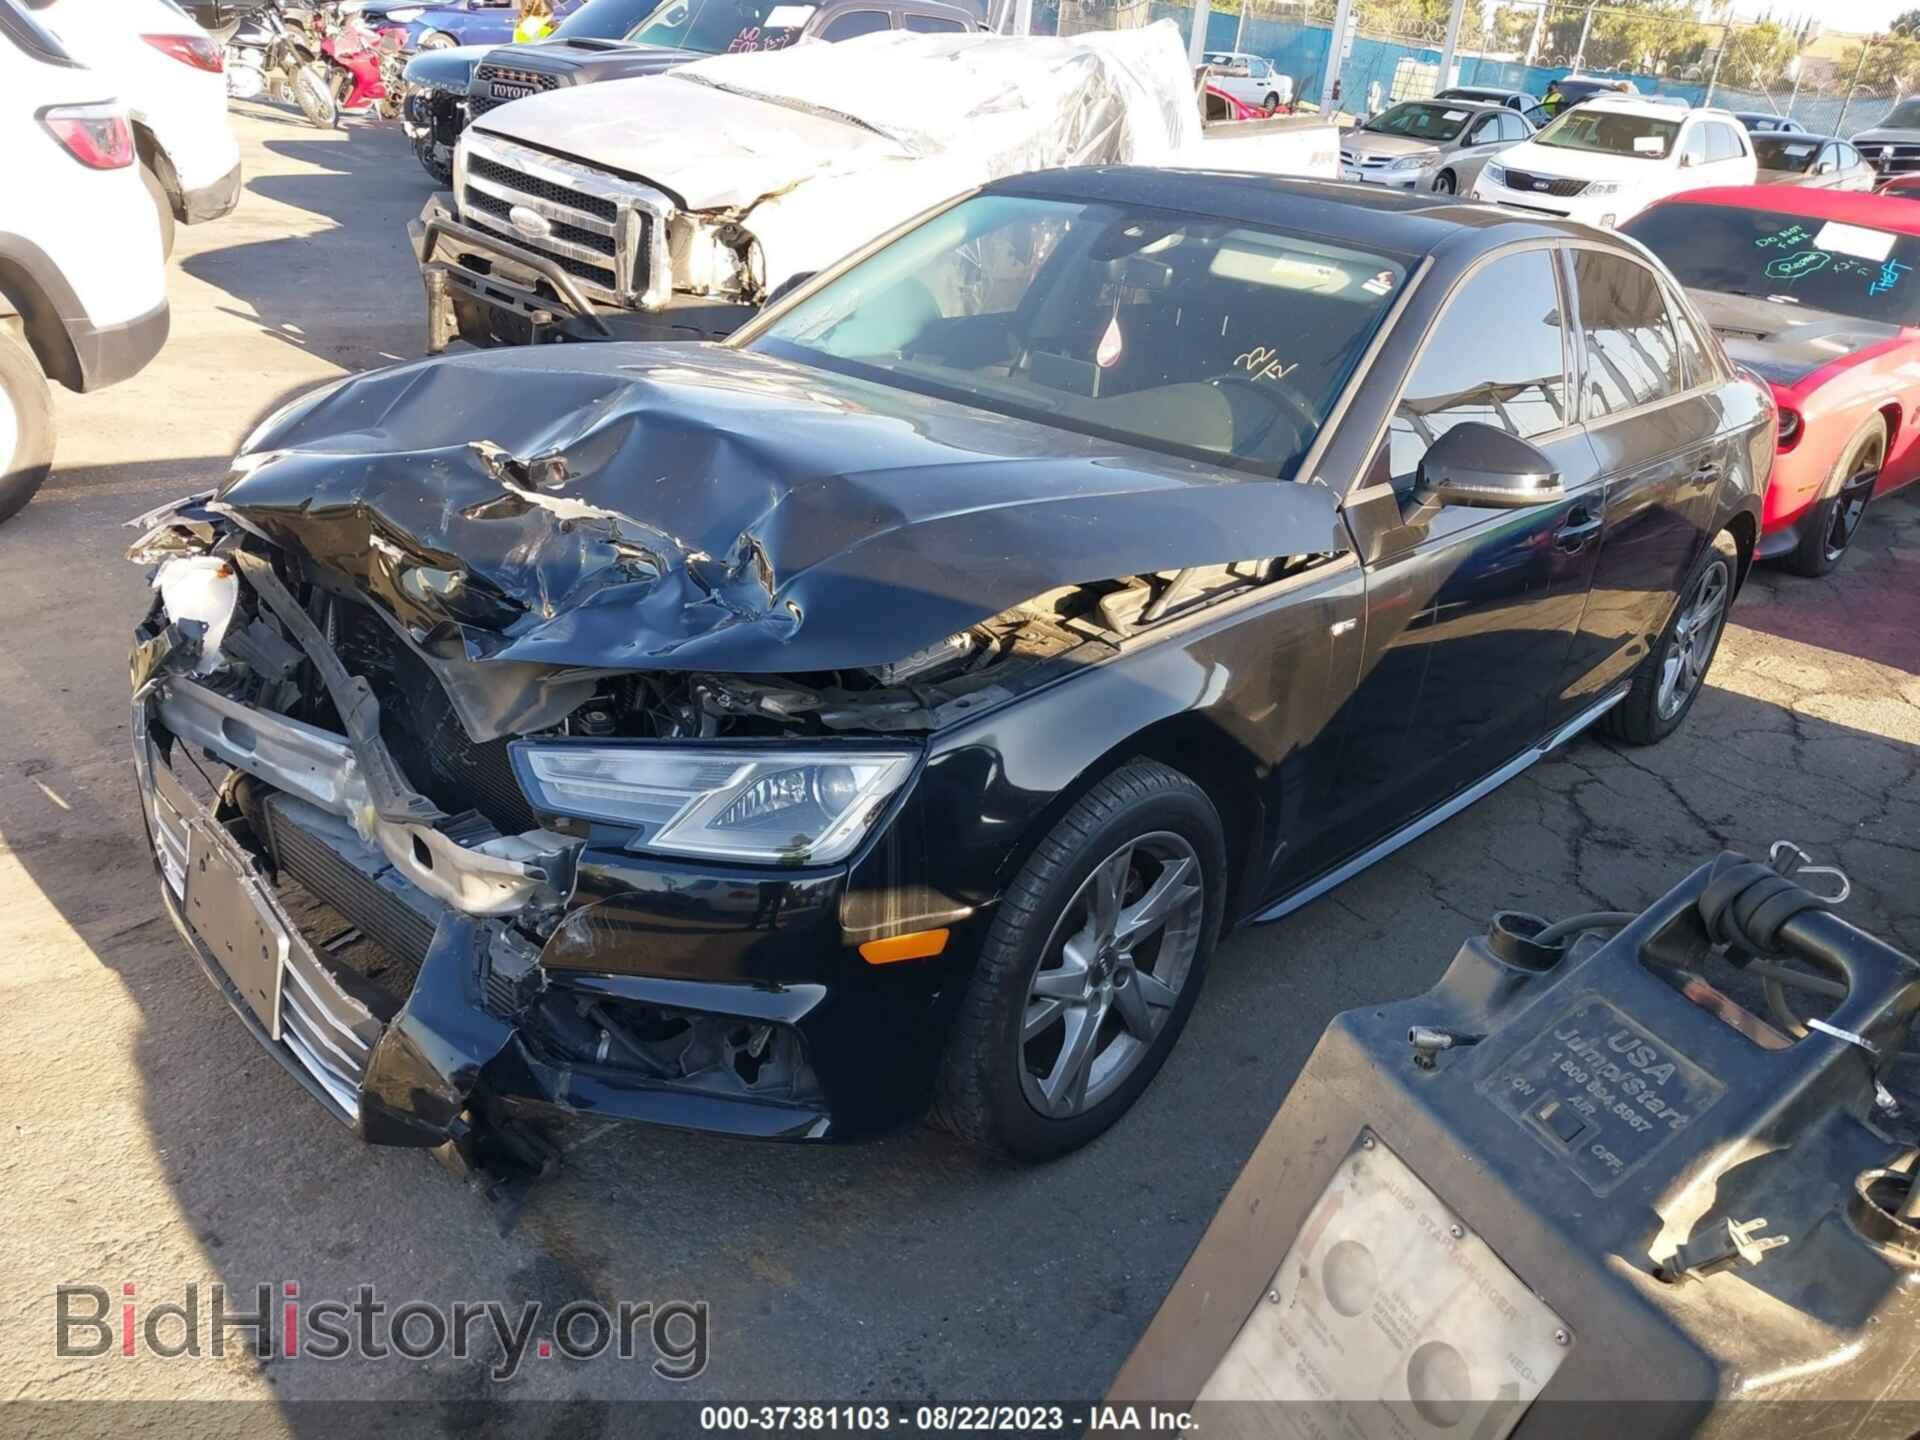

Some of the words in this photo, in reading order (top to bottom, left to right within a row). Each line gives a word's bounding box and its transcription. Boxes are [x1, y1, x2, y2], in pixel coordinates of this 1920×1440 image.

[738, 26, 760, 41] NO
[1607, 1029, 1676, 1086] USA
[1560, 1059, 1589, 1084] 800
[1512, 1077, 1535, 1096] ON
[1568, 1095, 1596, 1116] AIR
